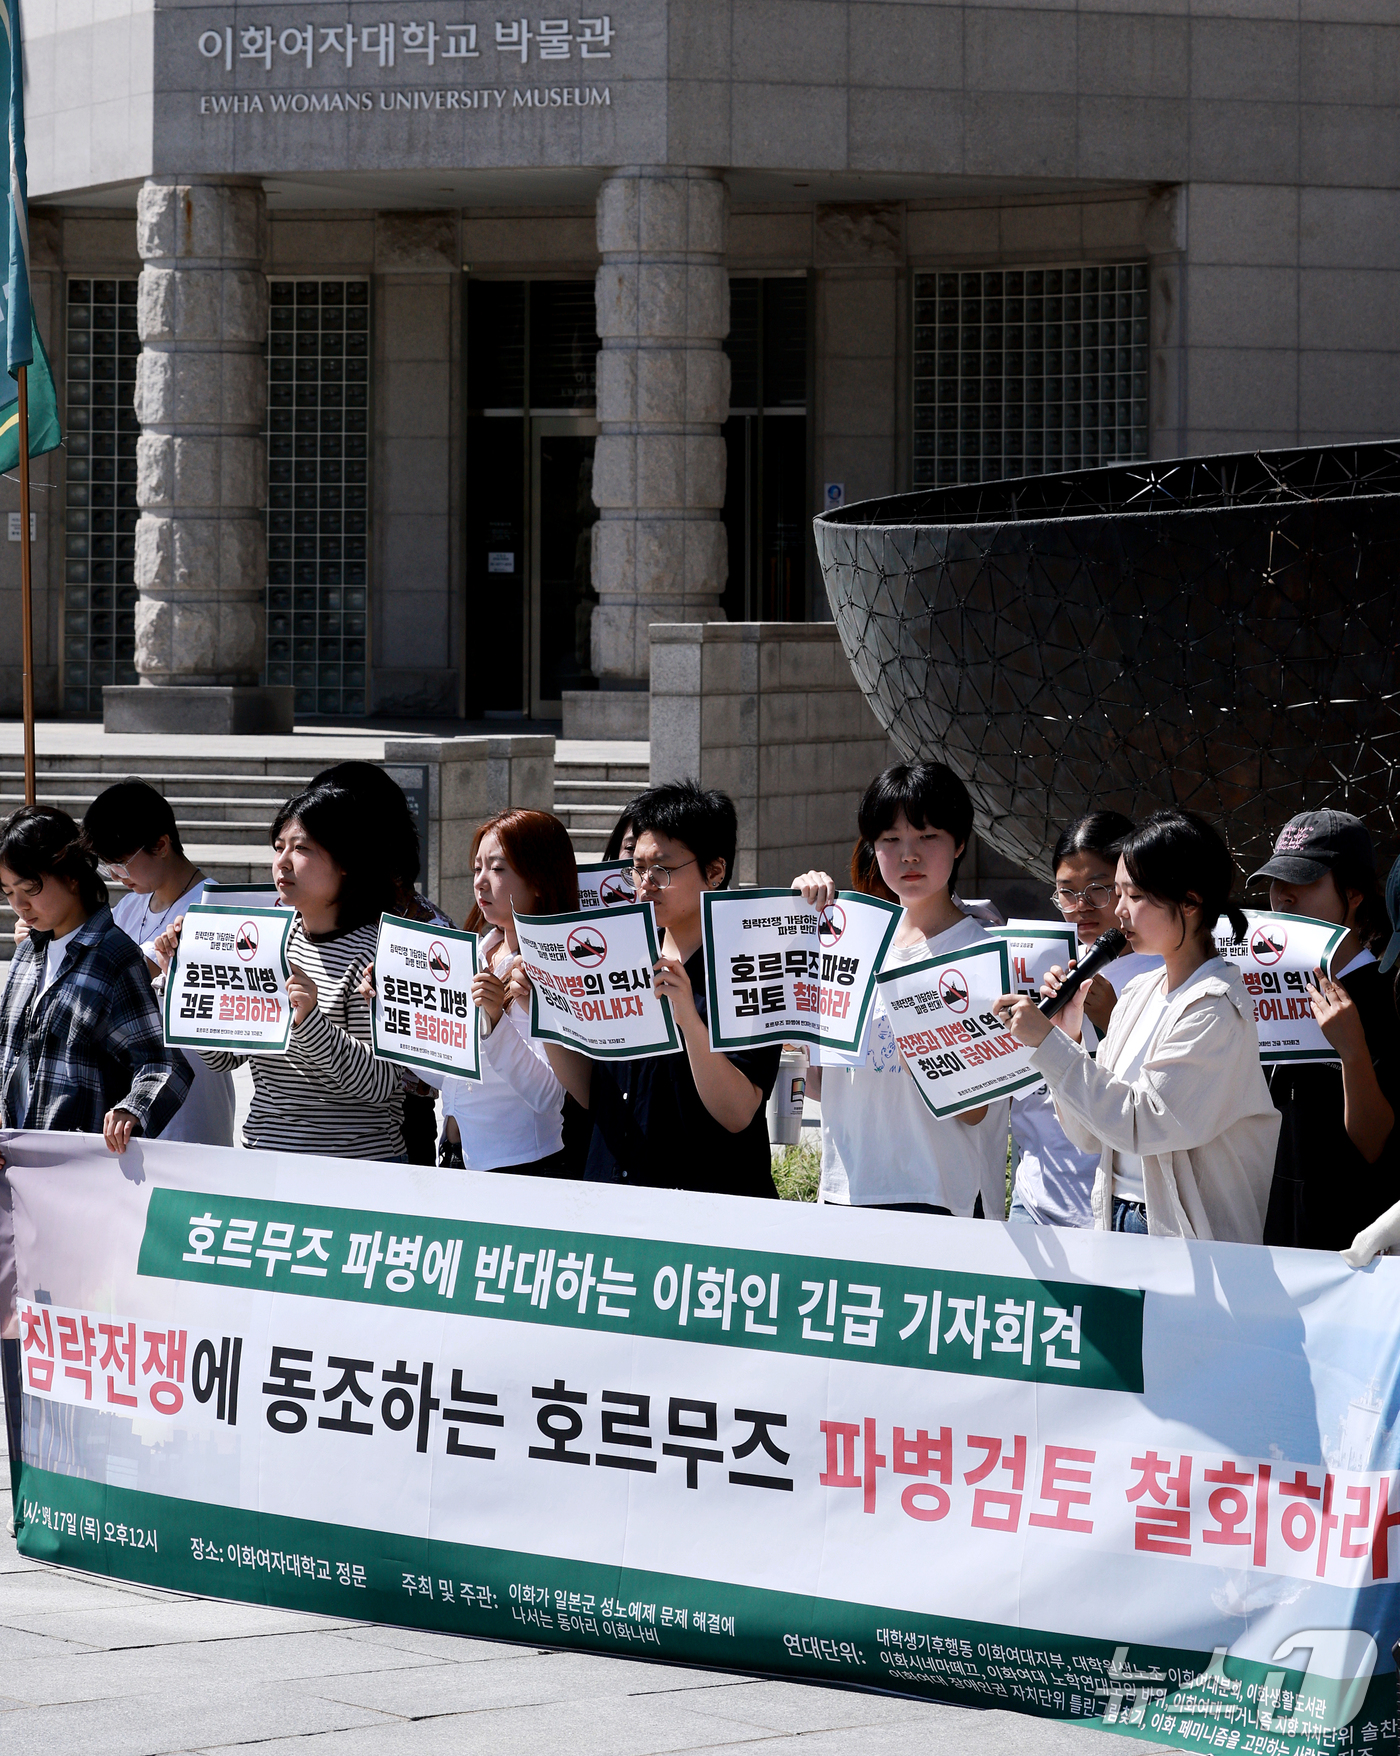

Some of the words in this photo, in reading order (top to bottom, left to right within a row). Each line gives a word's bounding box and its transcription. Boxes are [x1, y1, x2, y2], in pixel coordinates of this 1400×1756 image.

[198, 21, 480, 71] 이화여자대학교
[495, 16, 616, 64] 박물관
[200, 94, 264, 115] EWHA
[269, 92, 373, 113] WOMANS
[379, 88, 507, 111] UNIVERSITY
[512, 86, 612, 108] MUSEUM
[741, 916, 782, 929] 침략전쟁
[784, 914, 817, 925] 가담하는
[777, 925, 797, 935] 파병
[730, 950, 819, 983] 호르무즈
[821, 953, 860, 986] 파병
[1230, 947, 1248, 957] 반대!
[183, 961, 245, 991] 호르무즈
[244, 967, 279, 994] 파병
[553, 973, 605, 998] 파병의
[608, 967, 651, 993] 역사
[180, 993, 215, 1019] 검토
[218, 993, 282, 1023] 철회하라
[383, 975, 437, 1012] 호르무즈
[439, 987, 467, 1019] 파병
[569, 995, 644, 1022] 끊어내자
[732, 985, 786, 1017] 검토
[793, 981, 851, 1019] 철회하라
[1253, 997, 1317, 1022] 어내자
[384, 1007, 411, 1036] 검토
[414, 1012, 467, 1049] 철회하라
[896, 1029, 942, 1058] 전쟁과
[935, 1017, 987, 1047] 파병의
[918, 1051, 967, 1080] 청년이
[182, 1212, 333, 1277] 호르무즈
[342, 1231, 463, 1299] 파병에
[475, 1245, 637, 1318] 반대하는
[653, 1263, 780, 1335] 이화인
[797, 1279, 884, 1347] 긴급
[899, 1290, 1082, 1370] 기자회견
[21, 1305, 243, 1427] 침략전쟁에
[261, 1346, 505, 1460] 동조하는
[528, 1379, 794, 1492] 호르무즈
[819, 1417, 1097, 1534] 파병검토
[1125, 1450, 1400, 1580] 철회하라
[104, 1522, 158, 1553] 오후12시
[190, 1537, 224, 1563] 장소:
[227, 1544, 332, 1580] 이화여자대학교
[335, 1561, 367, 1589] 정문
[401, 1573, 433, 1600] 주최
[438, 1579, 455, 1604] 및
[460, 1583, 499, 1610] 주관:
[508, 1582, 550, 1609] 이화가
[553, 1589, 596, 1615] 일본군
[600, 1596, 656, 1625] 성노예제
[659, 1605, 688, 1630] 문제
[692, 1609, 736, 1637] 해결에
[512, 1607, 554, 1630] 나서는
[557, 1613, 600, 1637] 동아리
[602, 1621, 661, 1645] 이화나비
[783, 1633, 867, 1665] 연대단위:
[876, 1628, 973, 1659] 대학생기후행동
[1073, 1656, 1164, 1682] 대학원생노조
[1168, 1667, 1243, 1703] 이화여대분회,
[1246, 1683, 1326, 1720] 이화생활도서관
[888, 1669, 949, 1687] 이화여대
[948, 1676, 1009, 1698] 장애인권
[1011, 1684, 1065, 1711] 자치단위
[1069, 1693, 1146, 1730] 틀린그림찾기,
[1151, 1713, 1176, 1735] 이화
[1177, 1719, 1240, 1750] 페미니즘을
[987, 1664, 1048, 1685] 이화여대
[1050, 1671, 1136, 1702] 노학연대모임
[1141, 1685, 1169, 1711] 바위,
[1173, 1693, 1223, 1721] 이화여대
[1224, 1703, 1273, 1732] 비거니즘
[1275, 1715, 1299, 1738] 지향
[1301, 1721, 1354, 1747] 자치단위
